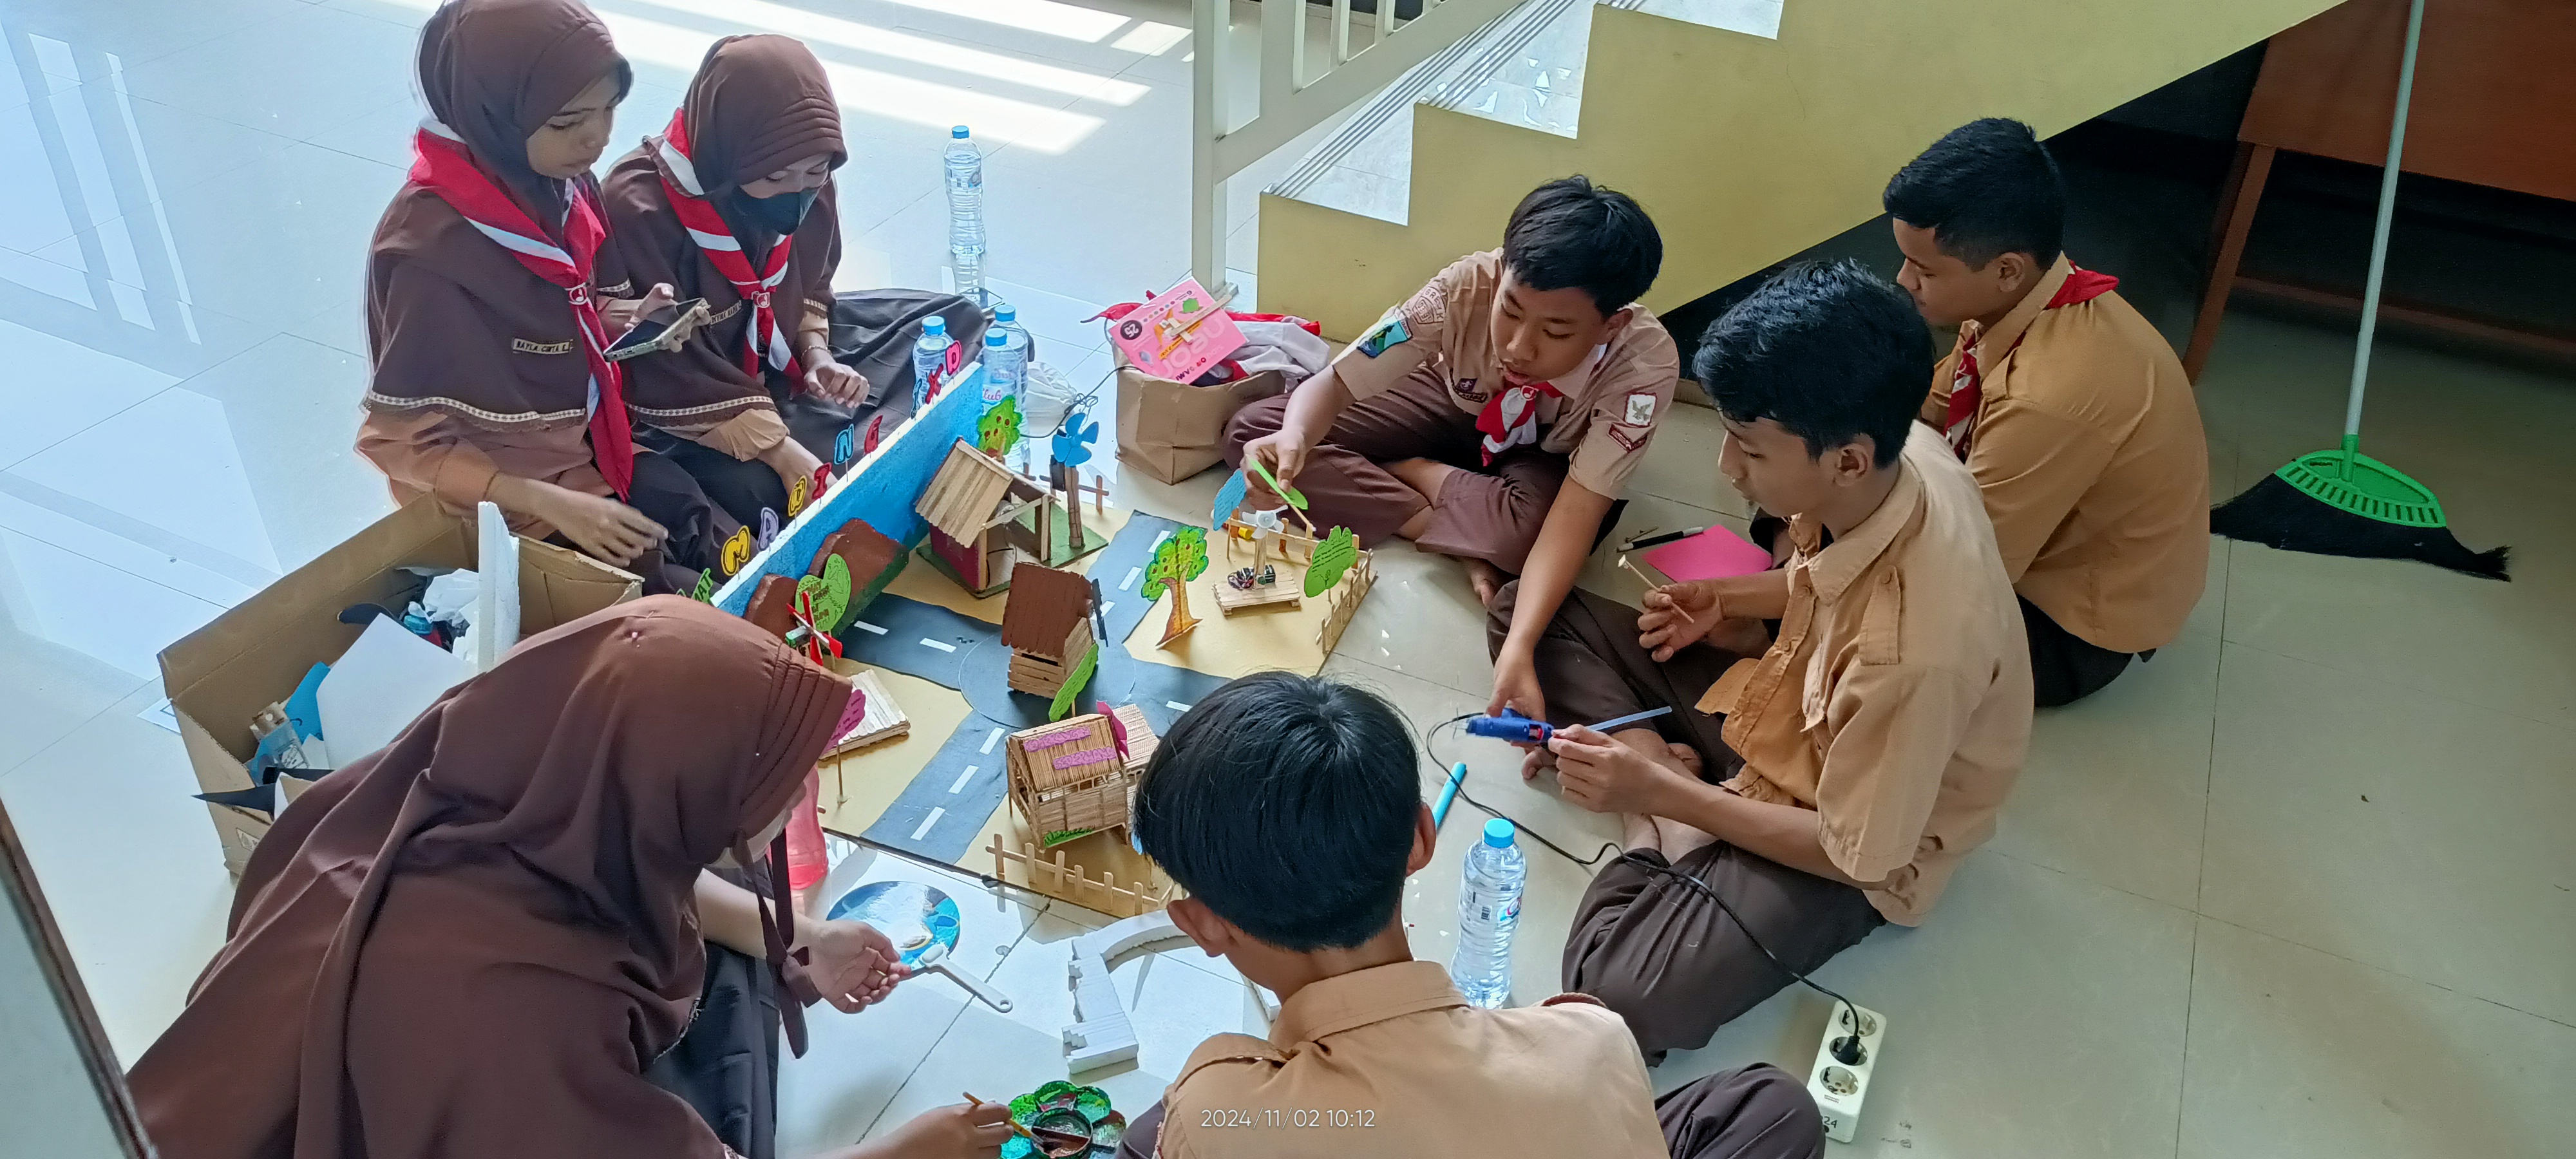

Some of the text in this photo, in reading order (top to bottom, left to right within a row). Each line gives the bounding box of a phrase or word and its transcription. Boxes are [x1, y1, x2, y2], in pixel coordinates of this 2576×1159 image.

[1124, 323, 1139, 338] 25
[1175, 357, 1207, 381] ORGAMI
[983, 388, 1001, 400] lub
[1821, 1115, 1838, 1129] 24
